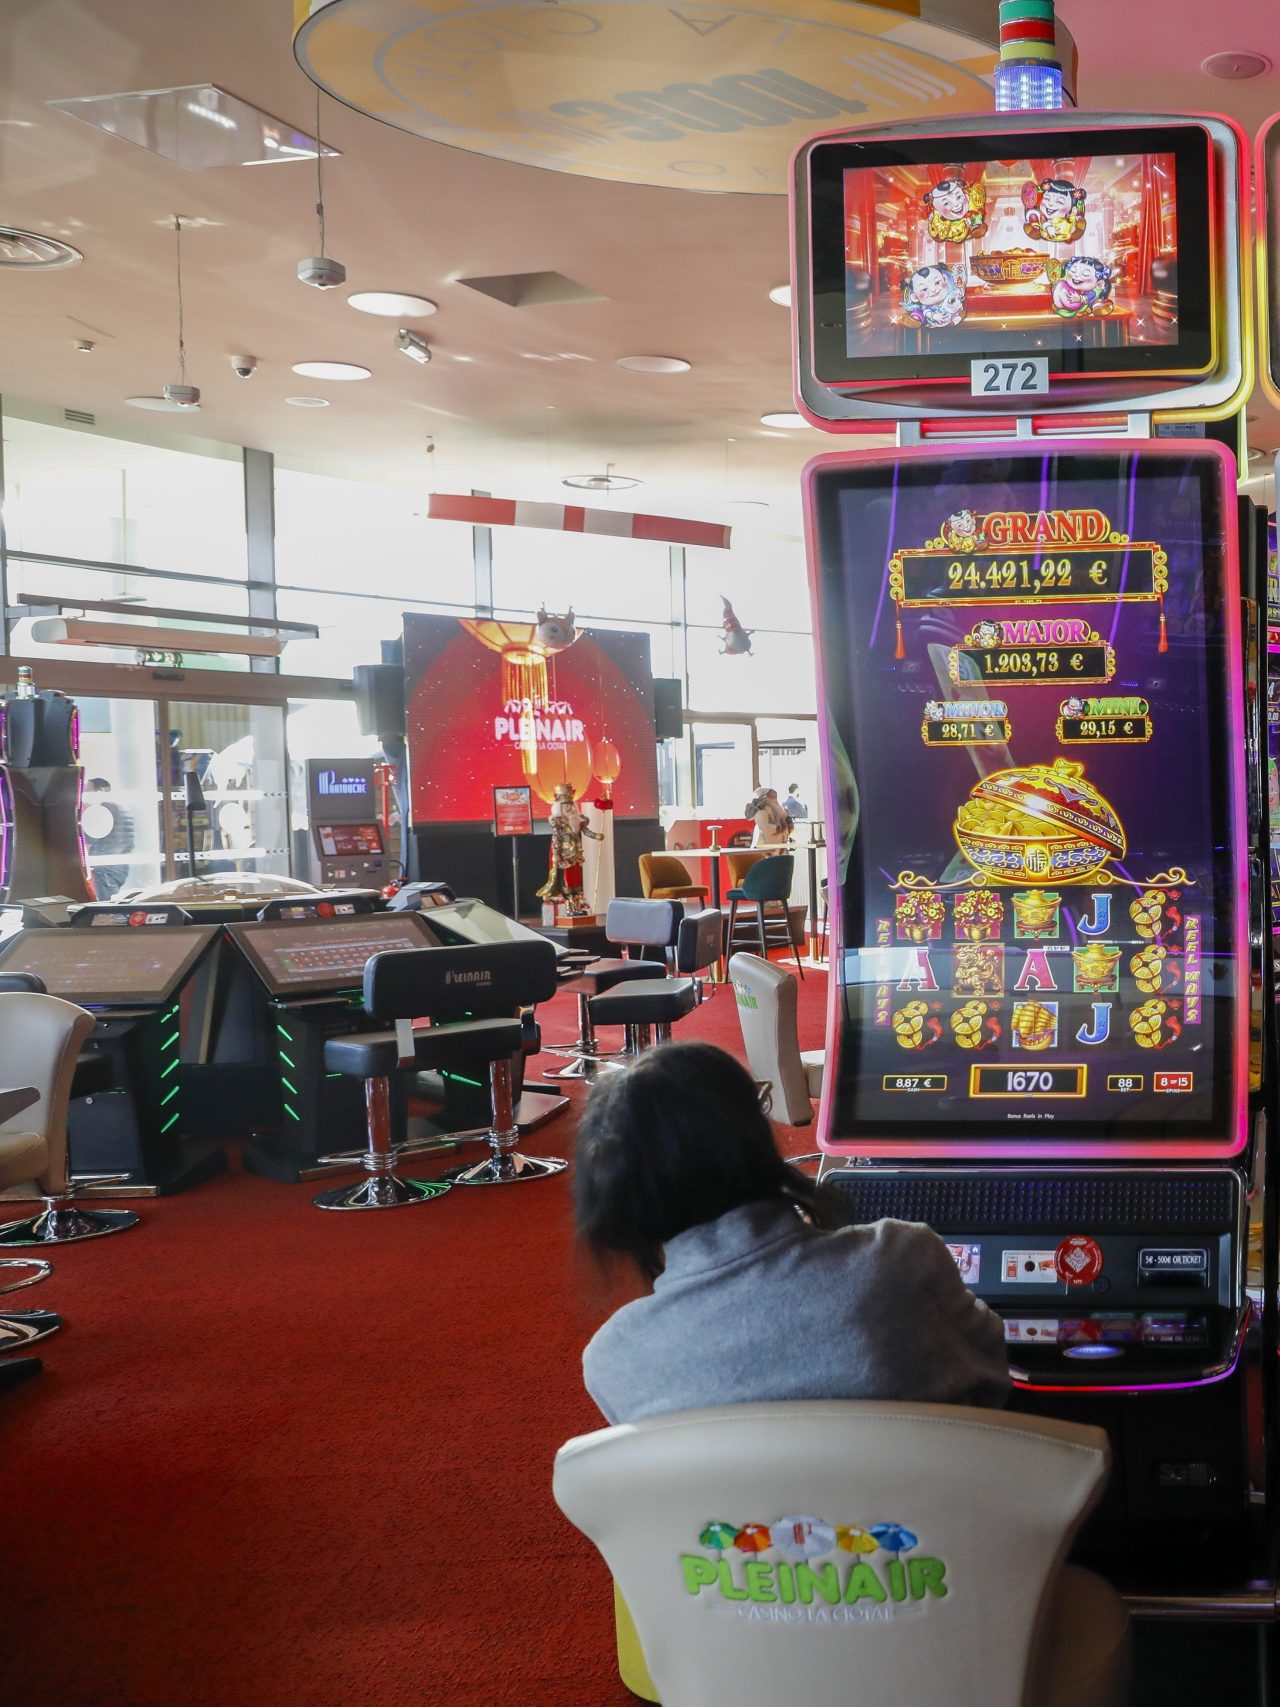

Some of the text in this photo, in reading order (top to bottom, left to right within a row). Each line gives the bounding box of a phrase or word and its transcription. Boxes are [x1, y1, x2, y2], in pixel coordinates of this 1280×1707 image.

[983, 362, 1038, 393] 272
[983, 509, 1107, 545] GRAND
[948, 559, 1108, 593] 24.421,22 €
[1002, 619, 1086, 646] MAJOR
[984, 652, 1084, 677] 1.203,73 €
[944, 701, 1006, 718] MINOR
[1087, 697, 1142, 716] MINI
[942, 723, 994, 741] 28,71 €
[1080, 721, 1134, 738] 29,15 €
[1077, 894, 1111, 935] J
[896, 949, 939, 991] A
[1014, 949, 1058, 991] A
[1182, 917, 1201, 1022] REEL WAYS
[1075, 1003, 1112, 1044] J
[923, 1078, 931, 1087] €
[1007, 1071, 1053, 1091] 1670
[1118, 1078, 1132, 1087] 88
[1161, 1077, 1168, 1086] 8
[1178, 1077, 1188, 1086] 15
[1182, 1255, 1202, 1264] TICKET
[681, 1553, 948, 1605] PLEINAIR
[735, 1605, 803, 1623] CASINO
[806, 1605, 829, 1622] LA
